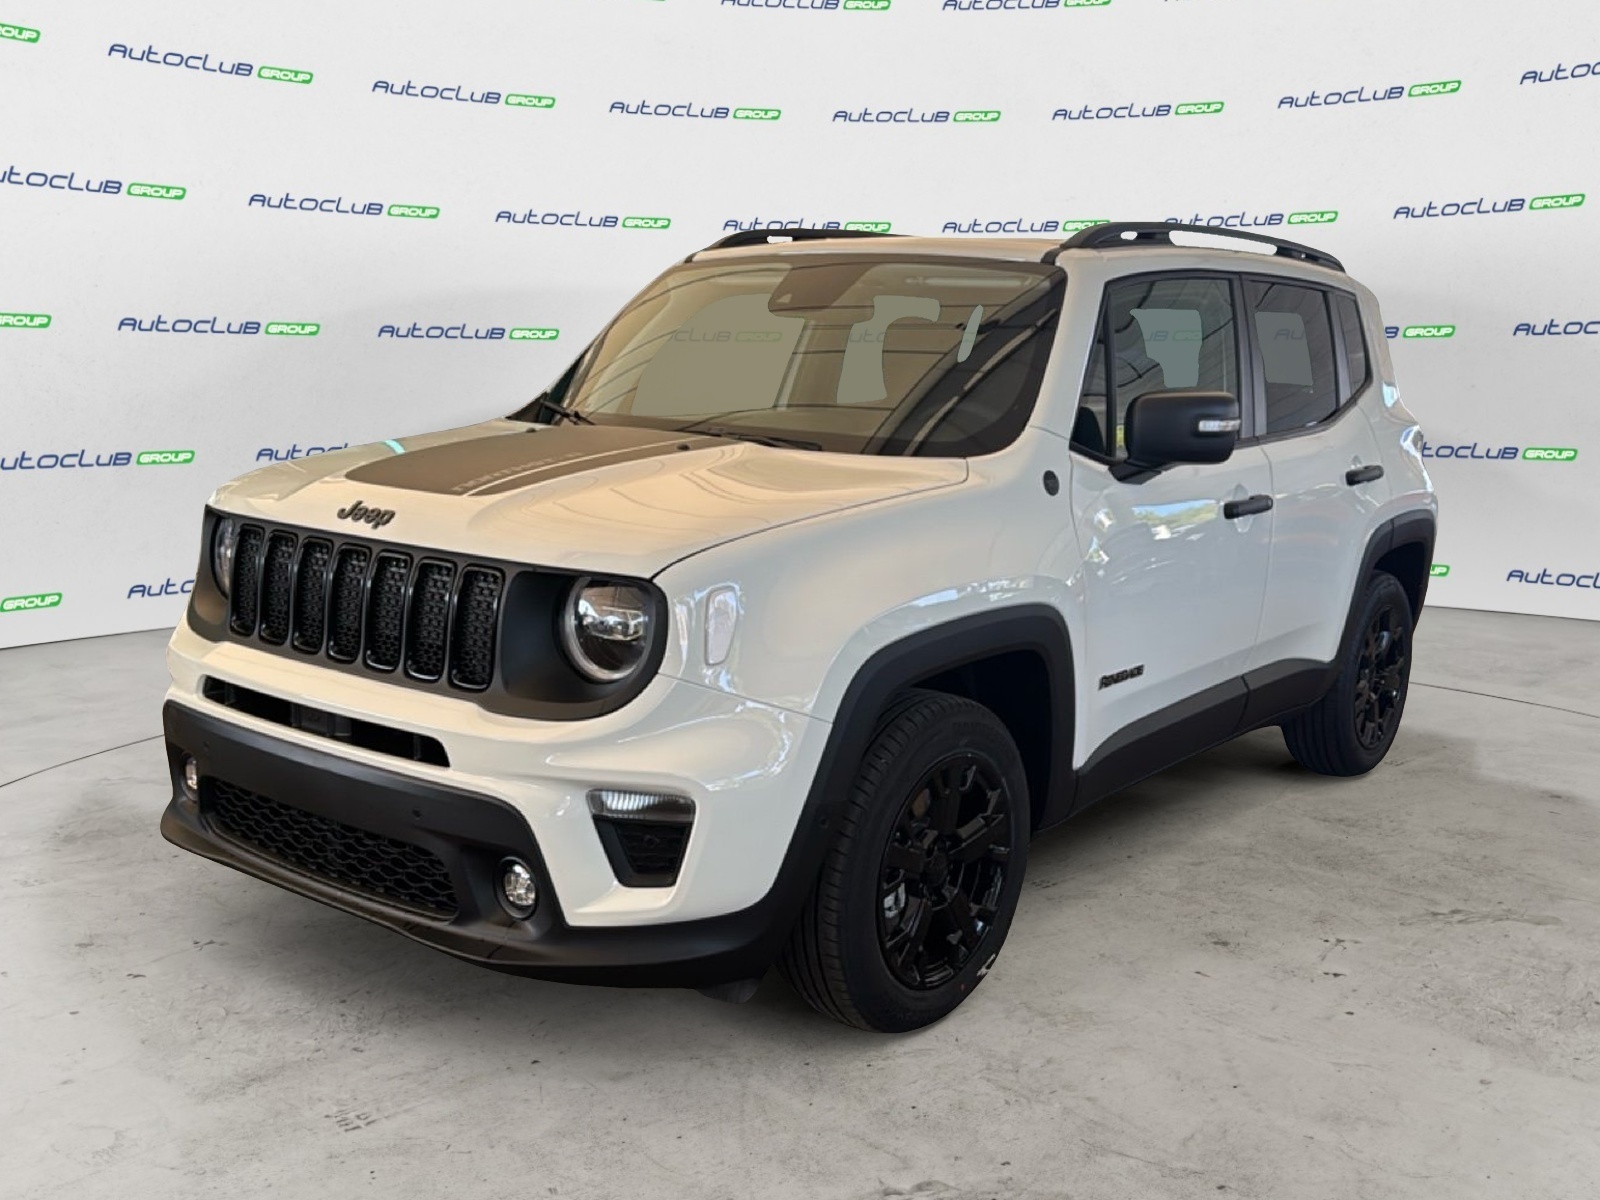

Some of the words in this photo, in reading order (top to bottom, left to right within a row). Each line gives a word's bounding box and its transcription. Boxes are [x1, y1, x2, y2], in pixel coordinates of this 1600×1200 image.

[845, 1, 890, 9] GROUP
[0, 25, 38, 41] OUP
[260, 67, 310, 82] GROUP
[1411, 82, 1459, 95] GROUP
[508, 96, 554, 108] GROUP
[737, 109, 778, 119] GROUP
[1178, 103, 1221, 114] GROUP
[957, 111, 998, 121] GROUP
[129, 185, 184, 198] GROUP
[1532, 196, 1583, 209] GROUP
[390, 207, 437, 217] GROUP
[623, 217, 668, 228] GROUP
[1289, 213, 1336, 223] GROUP
[846, 224, 889, 232] GROUP
[268, 324, 318, 335] GROUP
[512, 330, 557, 340] GROUP
[1405, 326, 1453, 337] GROUP
[138, 452, 192, 463] GROUP
[1525, 450, 1575, 460] GROUP
[337, 500, 396, 530] Jeep
[3, 595, 60, 611] GROUP
